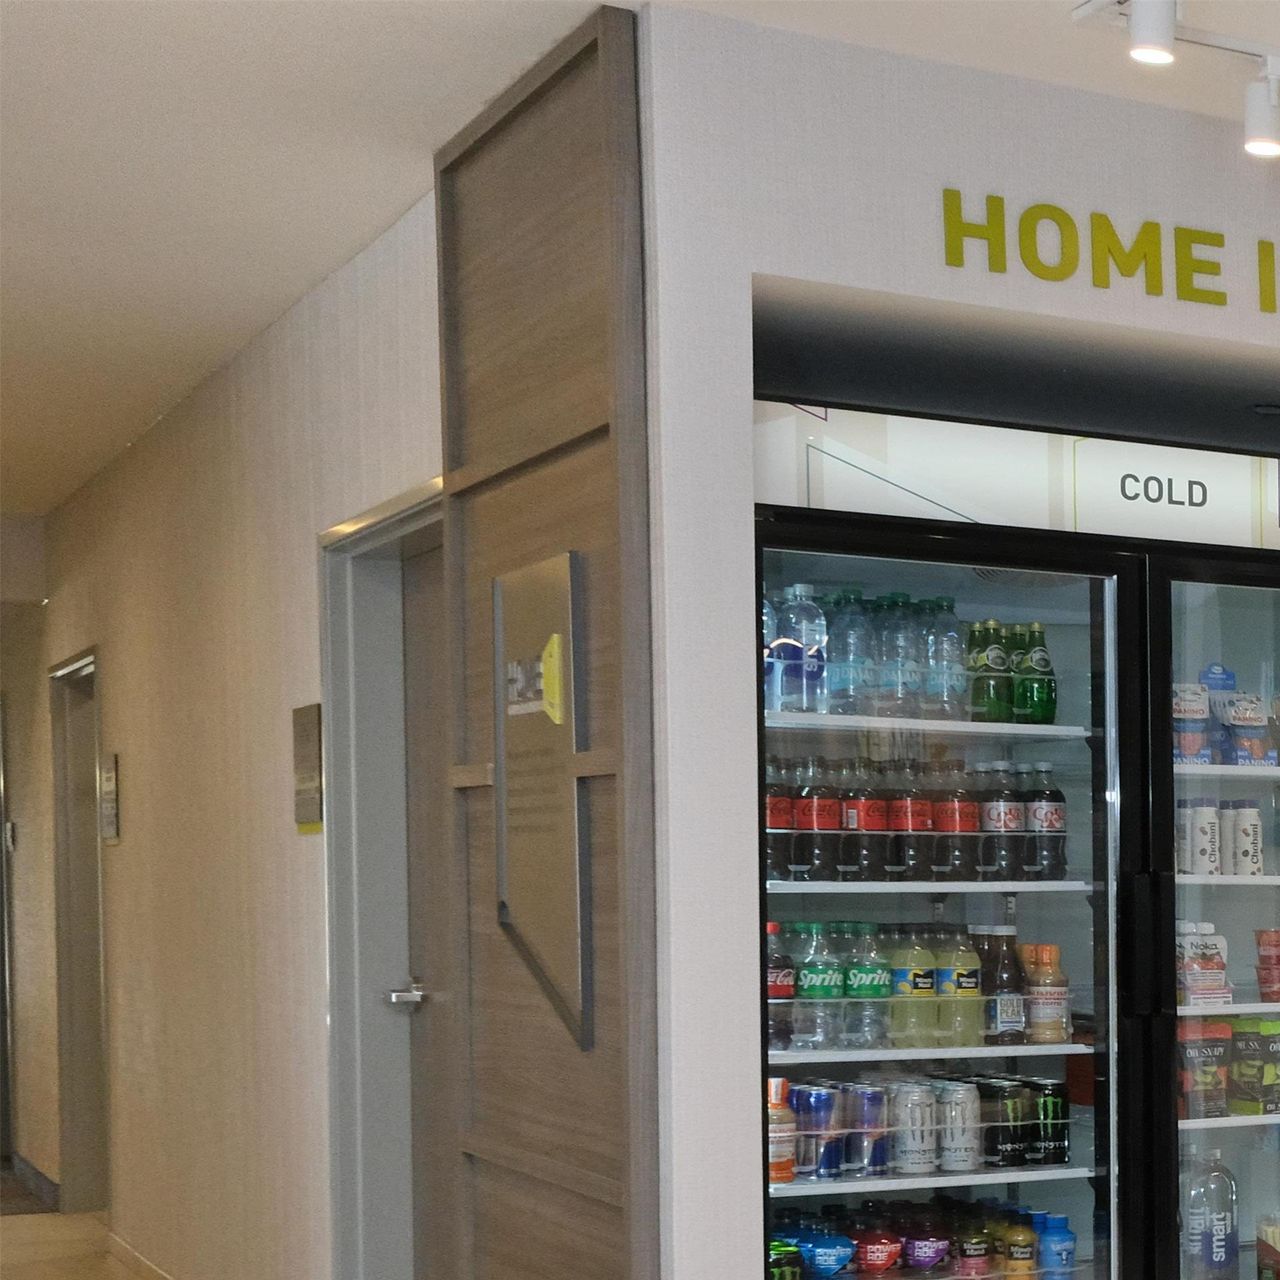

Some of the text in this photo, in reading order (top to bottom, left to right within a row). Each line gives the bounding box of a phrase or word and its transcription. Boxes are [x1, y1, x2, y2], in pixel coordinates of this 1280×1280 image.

[943, 188, 1227, 306] HOME
[1119, 473, 1209, 508] COLD
[1207, 821, 1217, 864] Chobani
[1250, 823, 1259, 865] Chobani
[1190, 941, 1219, 950] Noka
[798, 969, 843, 988] Sprite
[847, 969, 890, 988] Sprite
[999, 1007, 1023, 1017] PEAK
[914, 1241, 950, 1250] POWER
[1212, 1211, 1226, 1262] smart
[867, 1245, 901, 1254] POWER
